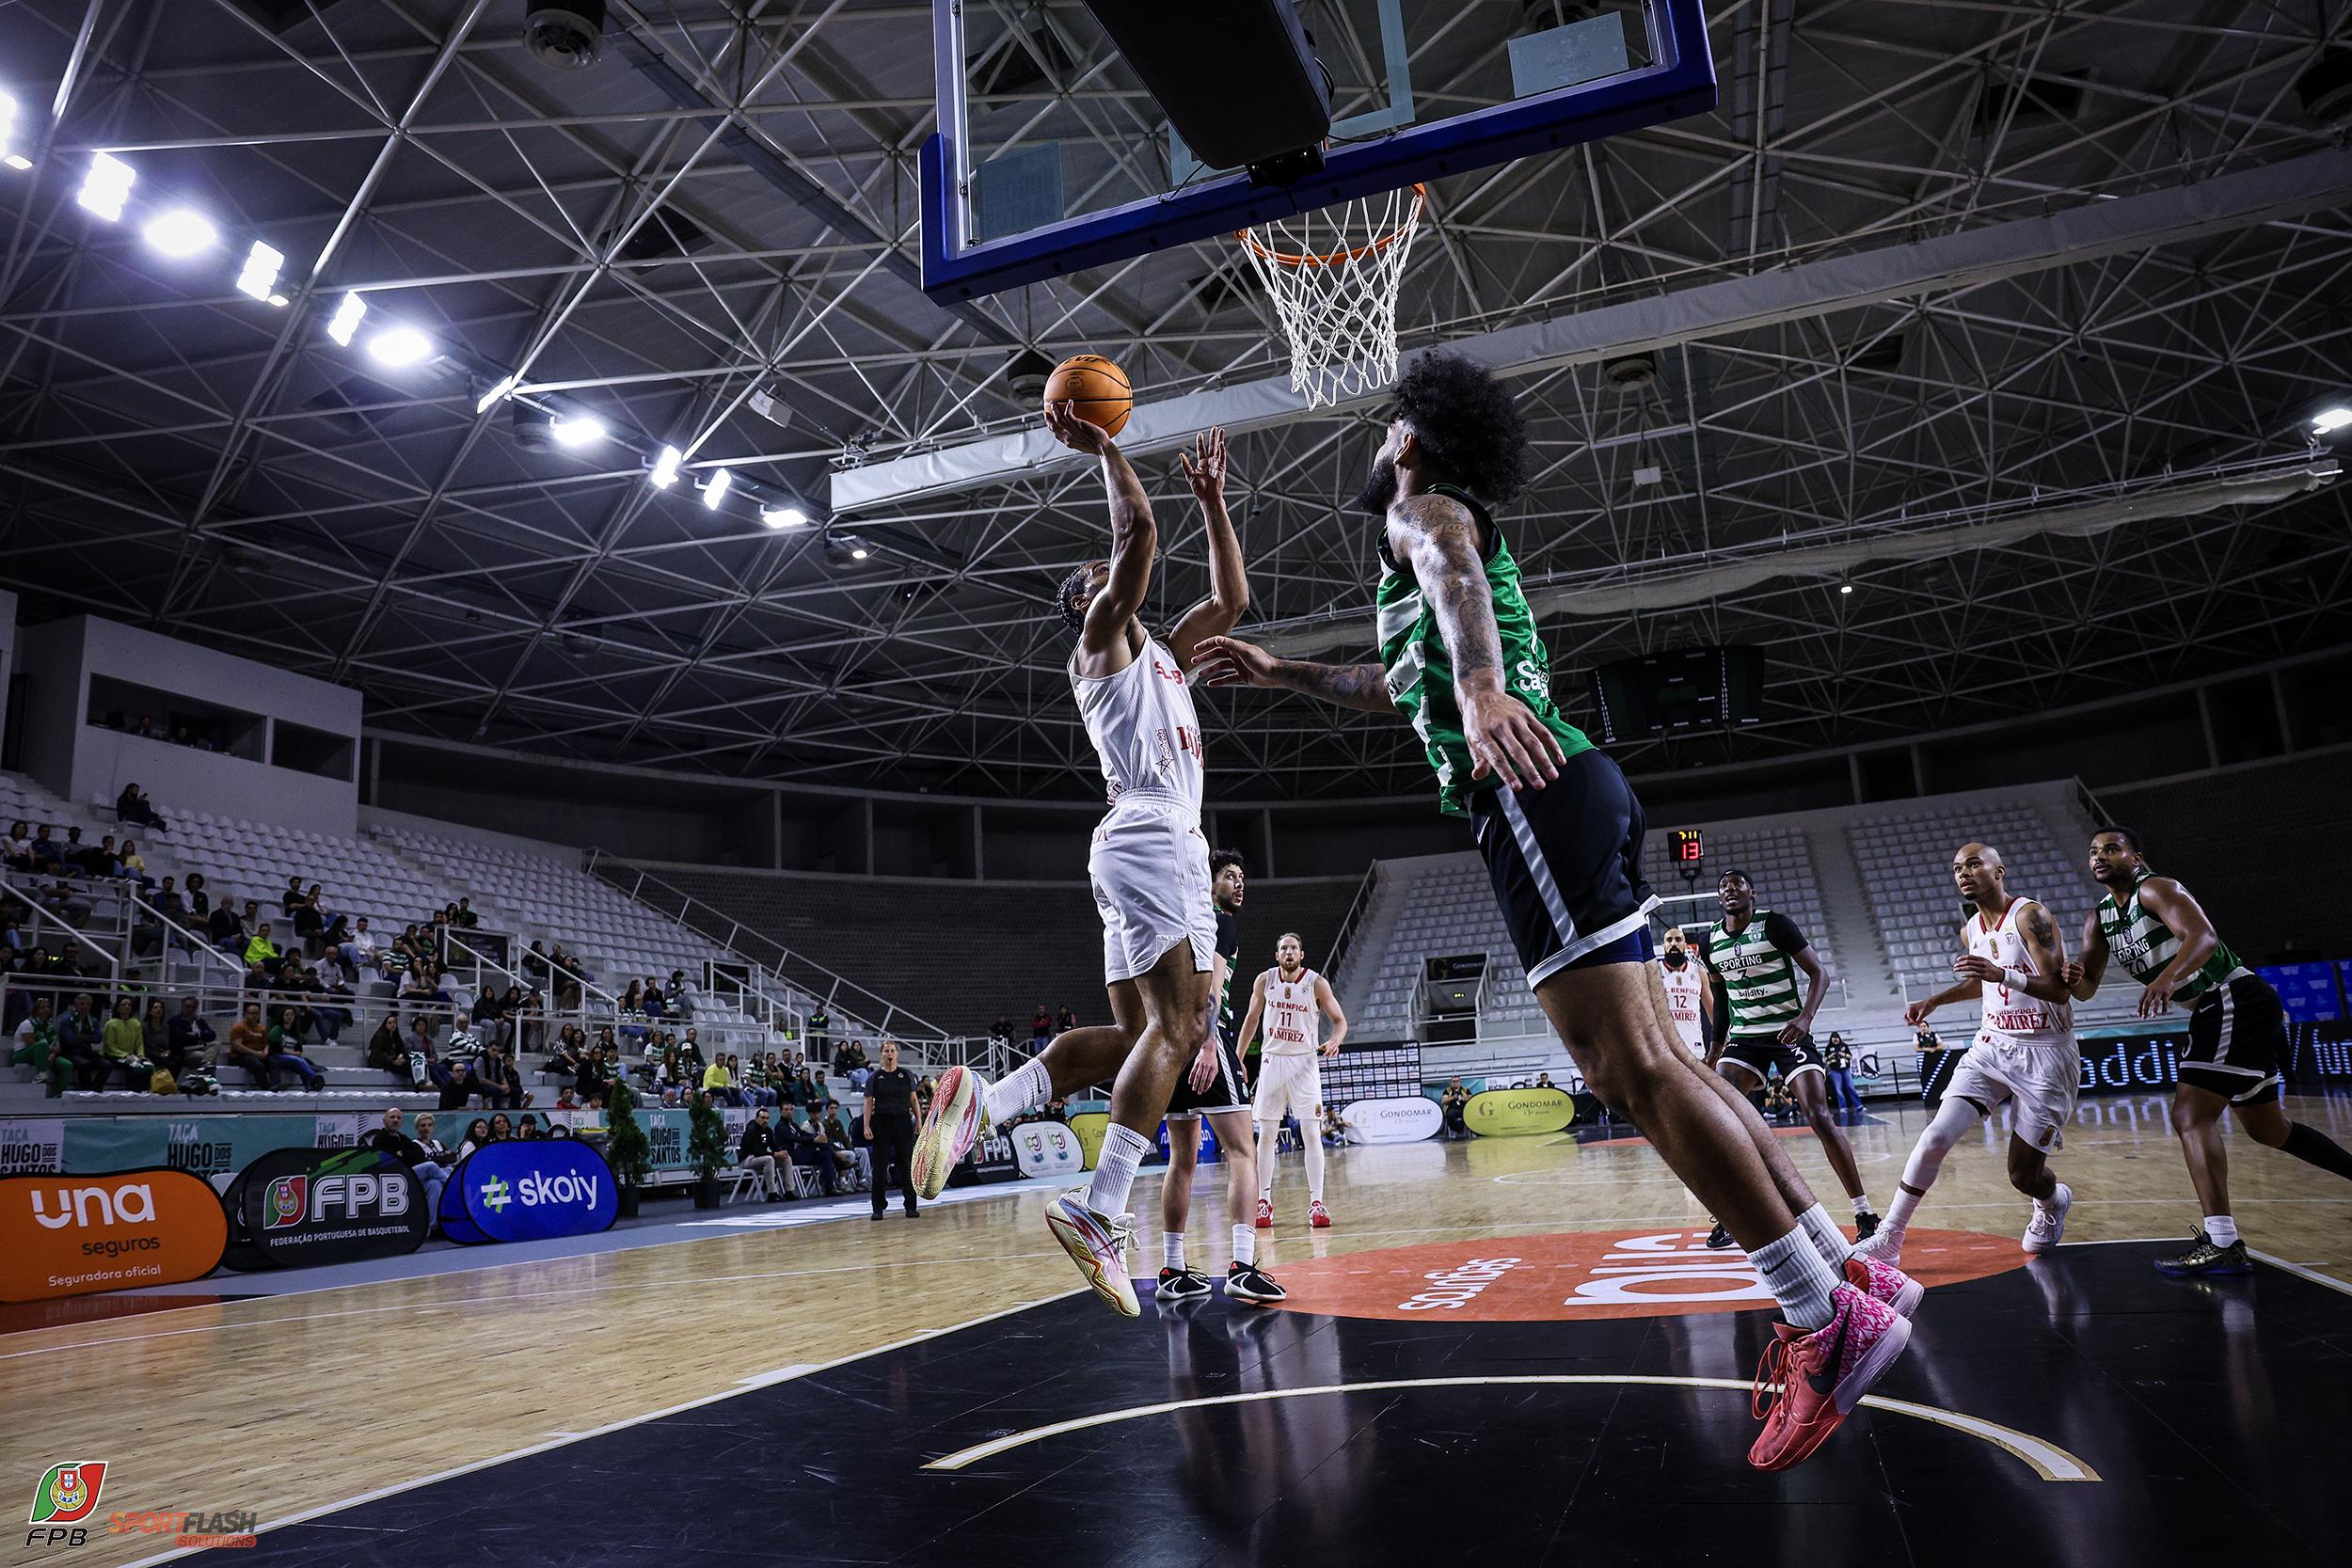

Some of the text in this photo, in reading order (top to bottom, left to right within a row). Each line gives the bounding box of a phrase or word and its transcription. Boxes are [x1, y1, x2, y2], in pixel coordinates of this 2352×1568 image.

[1682, 842, 1699, 860] 13
[1718, 955, 1763, 973] SPORTING
[1276, 1001, 1309, 1013] BENFICA
[1674, 995, 1687, 1008] 12
[1280, 1011, 1293, 1027] 11
[1790, 1046, 1807, 1064] 3
[1380, 1108, 1433, 1119] GONDOMAR
[1507, 1100, 1564, 1111] GONDOMAR
[318, 1133, 344, 1148] HUGO
[983, 1135, 1012, 1163] FPB
[0, 1143, 40, 1164] HUGO
[167, 1143, 213, 1168] HUGO
[650, 1147, 682, 1165] SANTOS
[30, 1183, 156, 1229] una
[310, 1173, 409, 1223] FPB
[270, 1226, 410, 1247] FEDERAÇÃO PORTUGUESA DE BASQUETEBOL
[82, 1236, 161, 1259] seguros
[48, 1263, 161, 1287] Seguradora oficial
